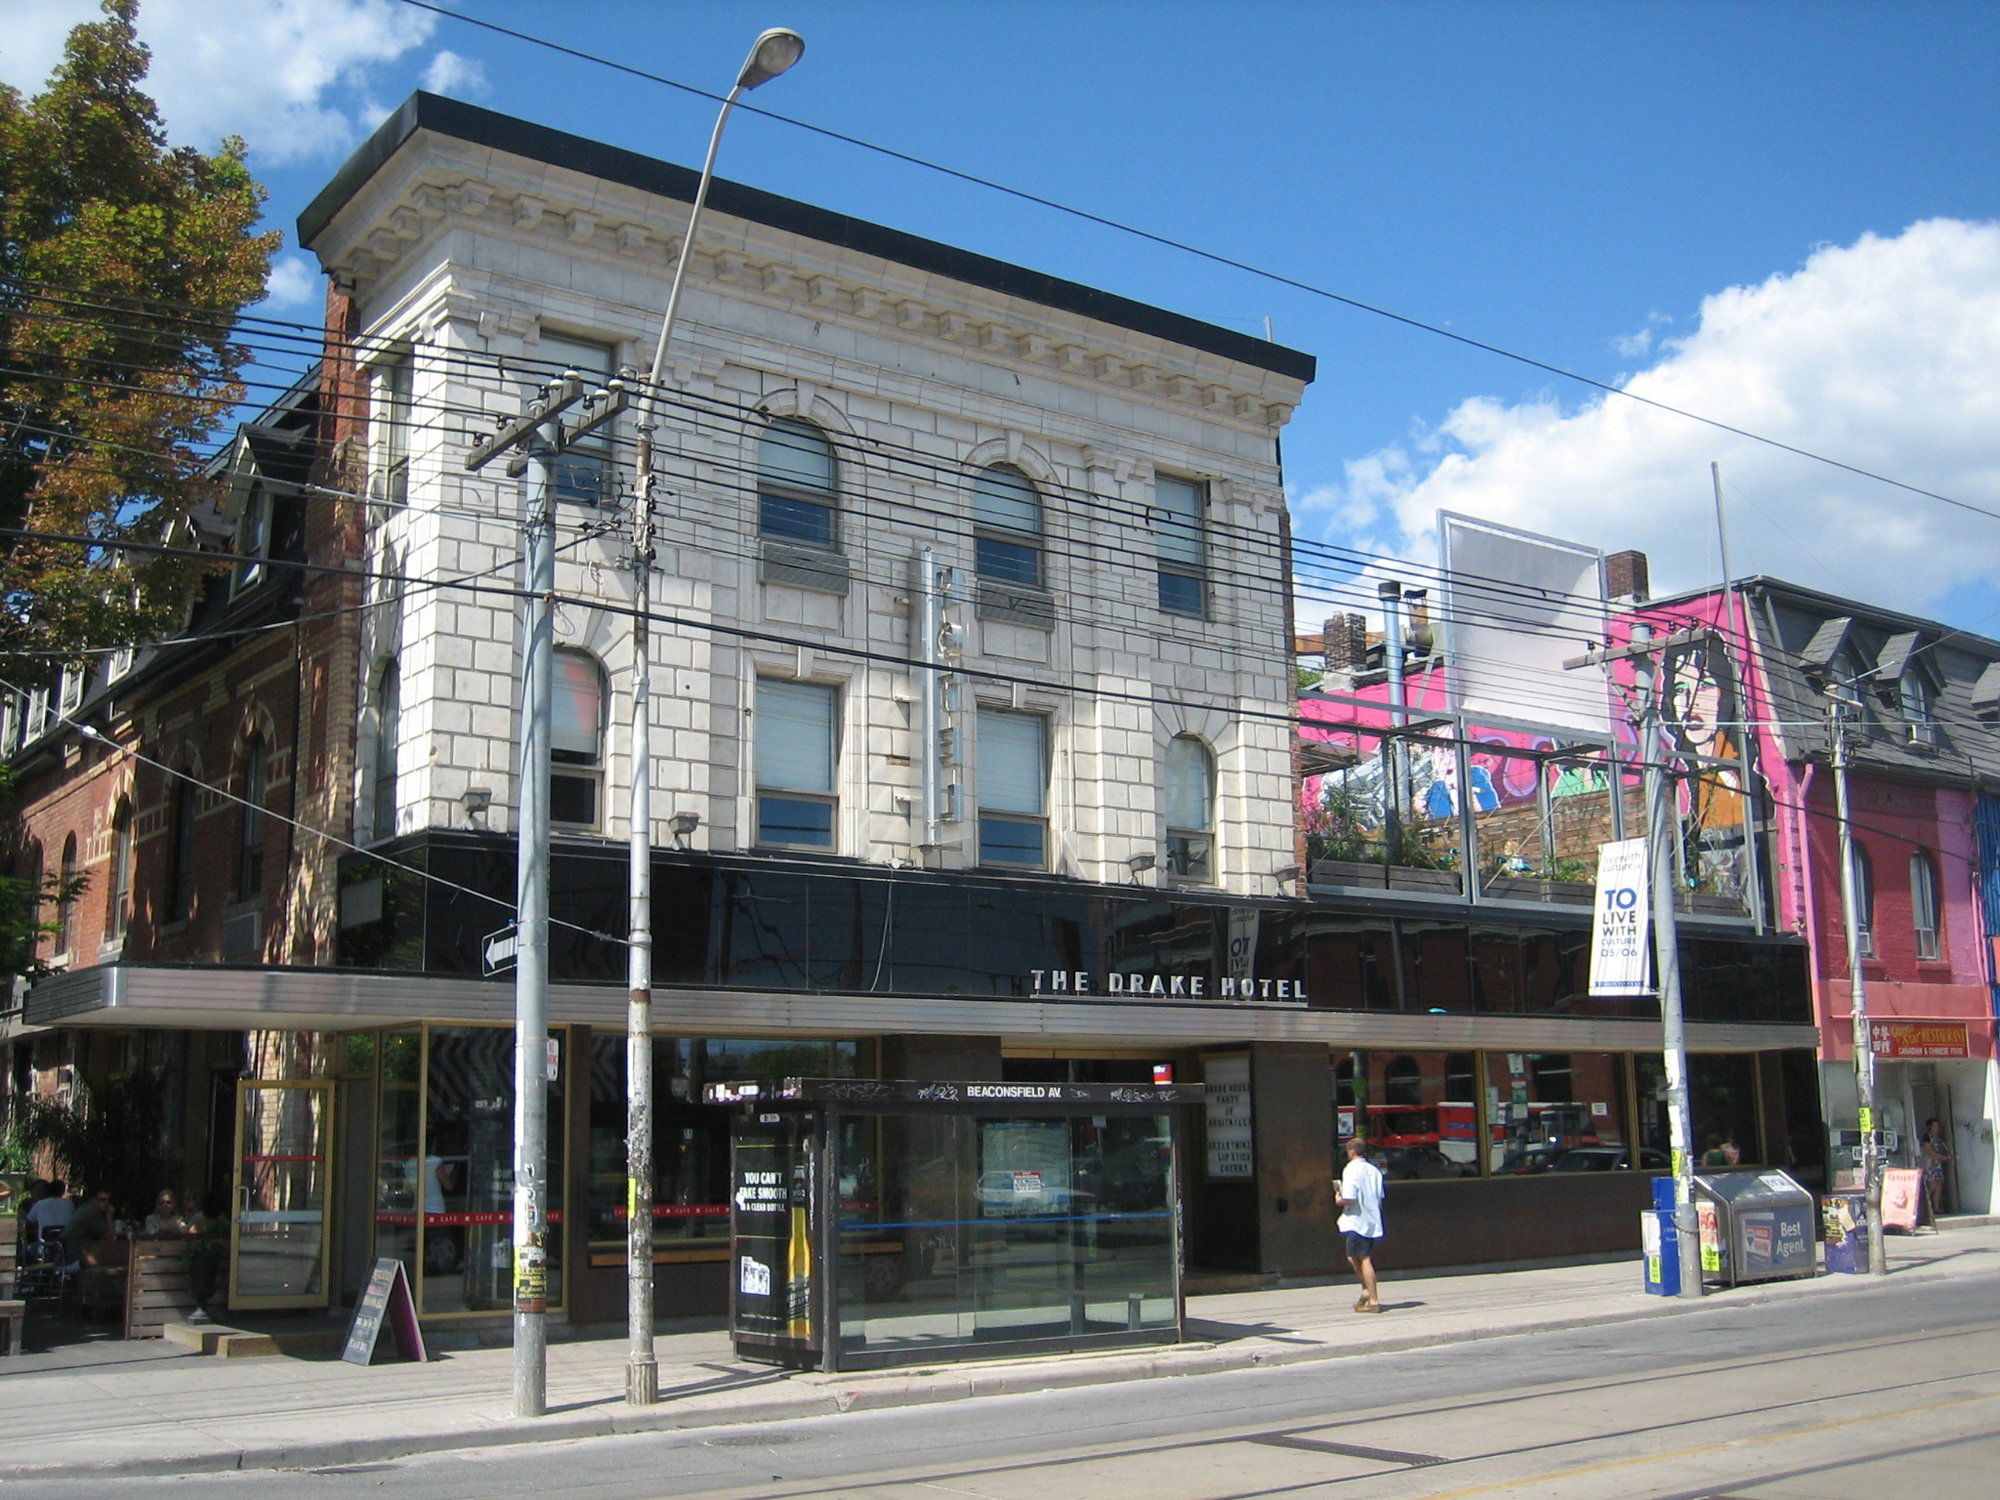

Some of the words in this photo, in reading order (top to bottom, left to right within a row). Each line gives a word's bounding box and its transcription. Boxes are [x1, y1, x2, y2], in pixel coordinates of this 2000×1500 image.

[1604, 887, 1637, 910] TO
[1603, 911, 1636, 925] LIVE
[1602, 925, 1637, 937] WITH
[1601, 937, 1637, 946] CULTURE
[1600, 948, 1637, 957] 05/06
[1030, 969, 1088, 991] THE
[1109, 972, 1204, 995] DRAKE
[1221, 977, 1307, 998] HOTEL
[1922, 1027, 1965, 1044] RESTAURANT
[967, 1085, 1045, 1098] BEACONSFIELD
[1048, 1086, 1062, 1098] AV.
[1216, 1095, 1238, 1104] PARTY
[744, 1171, 760, 1185] YOU
[760, 1171, 783, 1185] CAN'T
[758, 1187, 788, 1201] SMOOTH
[751, 1202, 766, 1211] CLEAR
[1780, 1222, 1801, 1237] Best
[1776, 1239, 1807, 1258] Agent.
